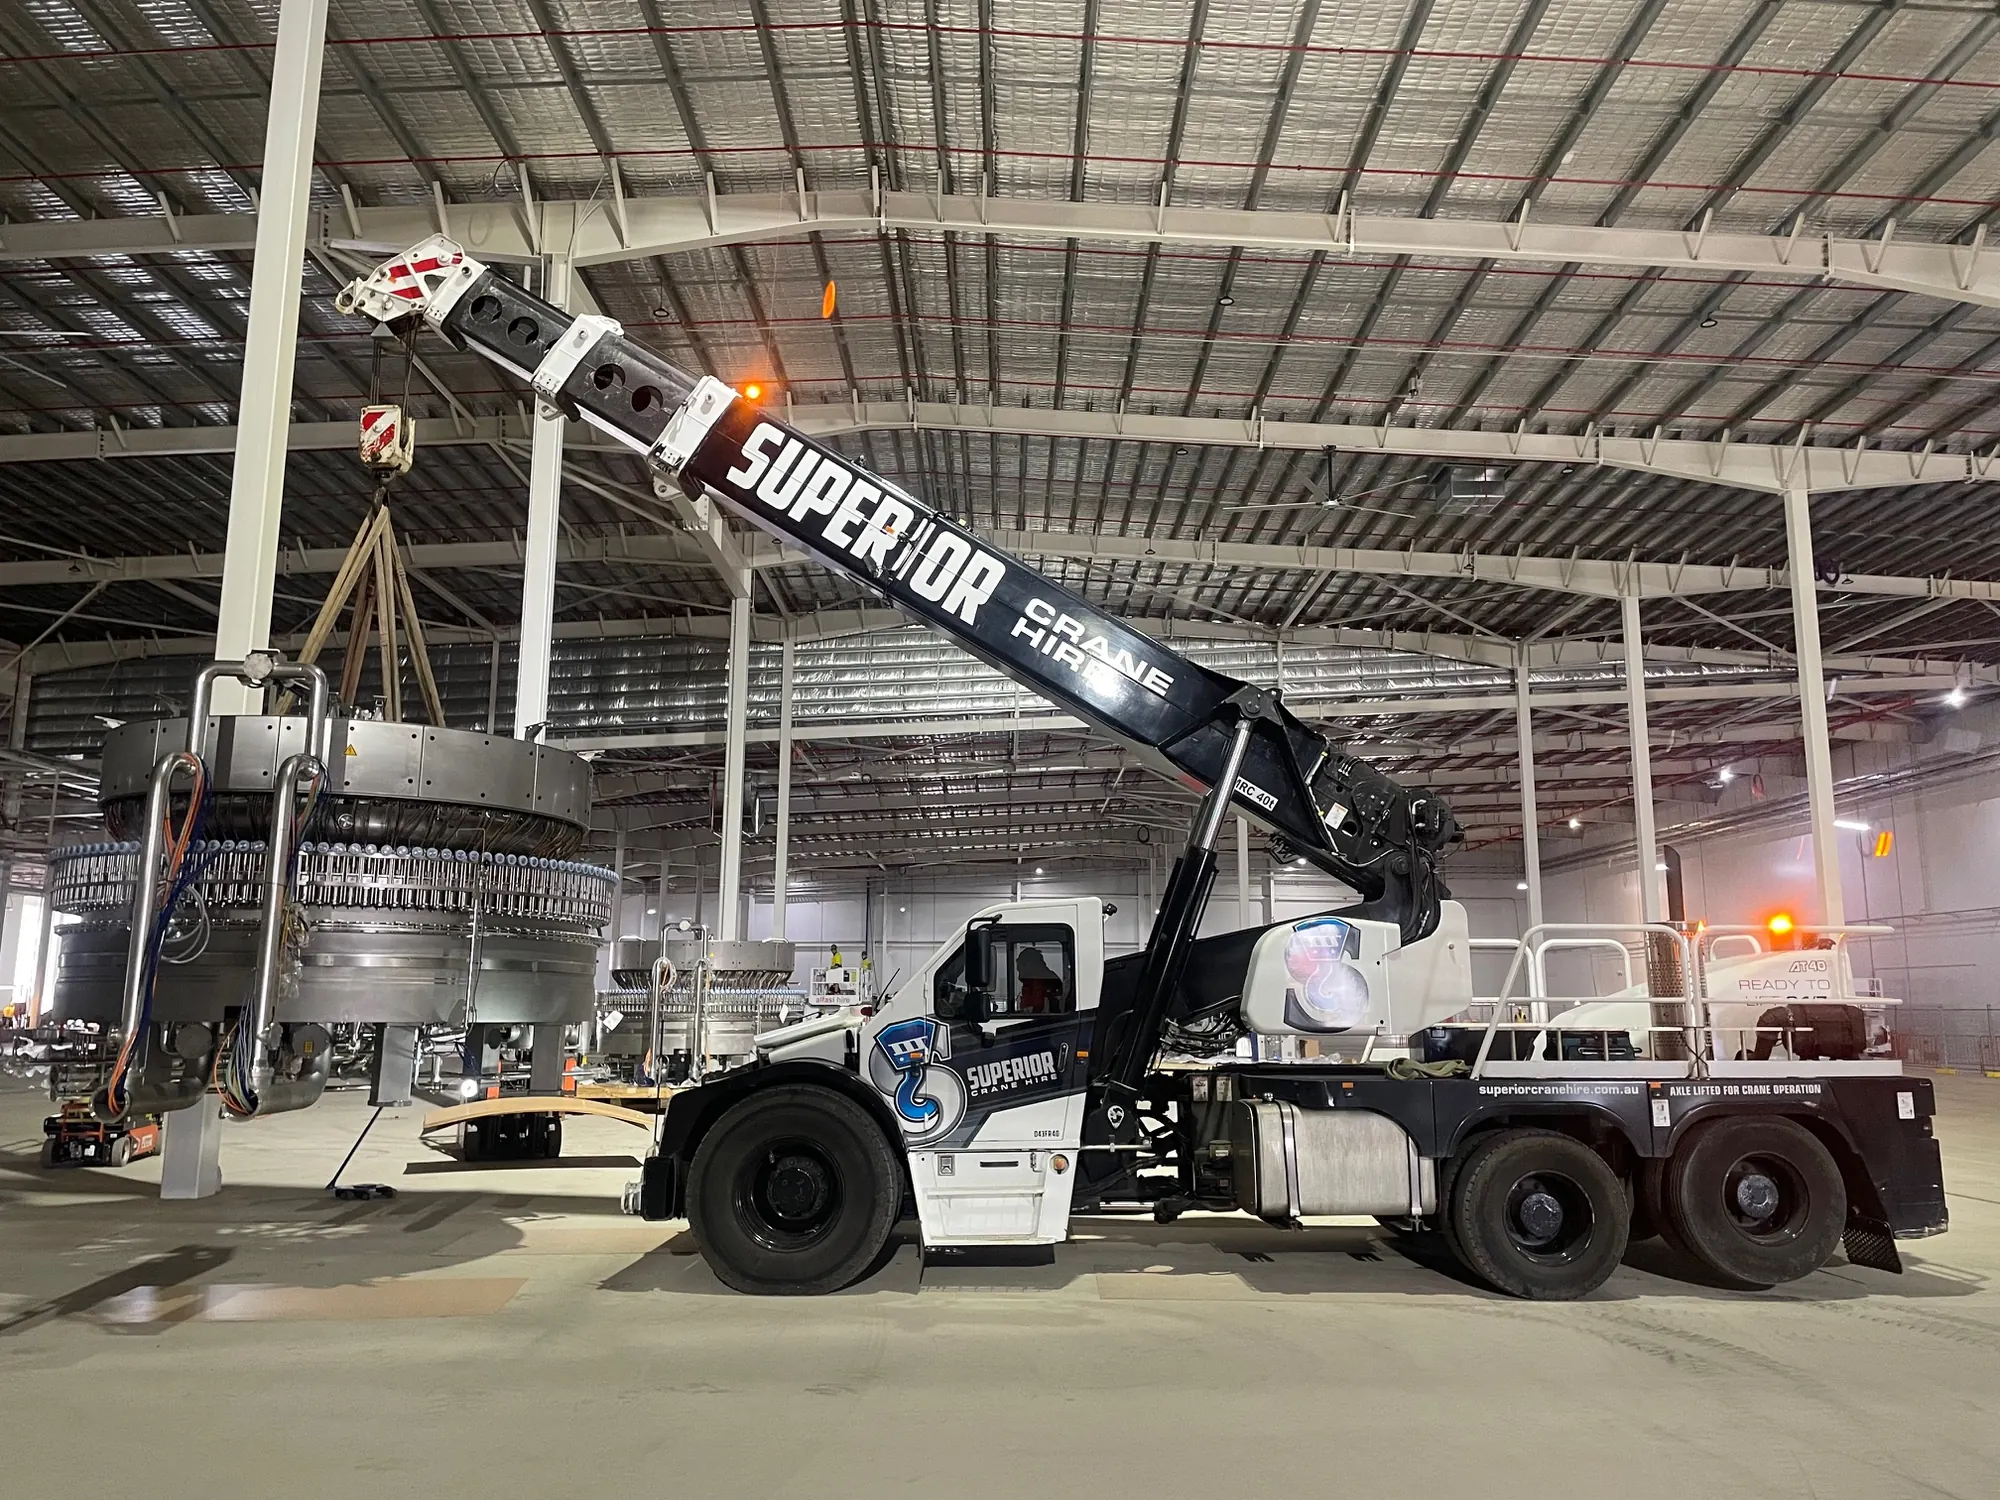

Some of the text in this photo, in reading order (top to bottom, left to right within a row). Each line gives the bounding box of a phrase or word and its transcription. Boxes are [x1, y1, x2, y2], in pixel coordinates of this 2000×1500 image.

[726, 422, 1006, 626] SUPERIOR
[1024, 598, 1174, 697] CRANE
[1257, 792, 1275, 809] 40t
[1788, 960, 1827, 973] AT40
[1738, 979, 1831, 990] READY TO
[966, 1051, 1056, 1090] SUPERIOR
[970, 1073, 1058, 1097] CRANE HIRE
[1478, 1083, 1640, 1098] superiorcranehire.com.au
[1669, 1084, 1822, 1097] AXLE LIFTED FOR CRANE OPERATION
